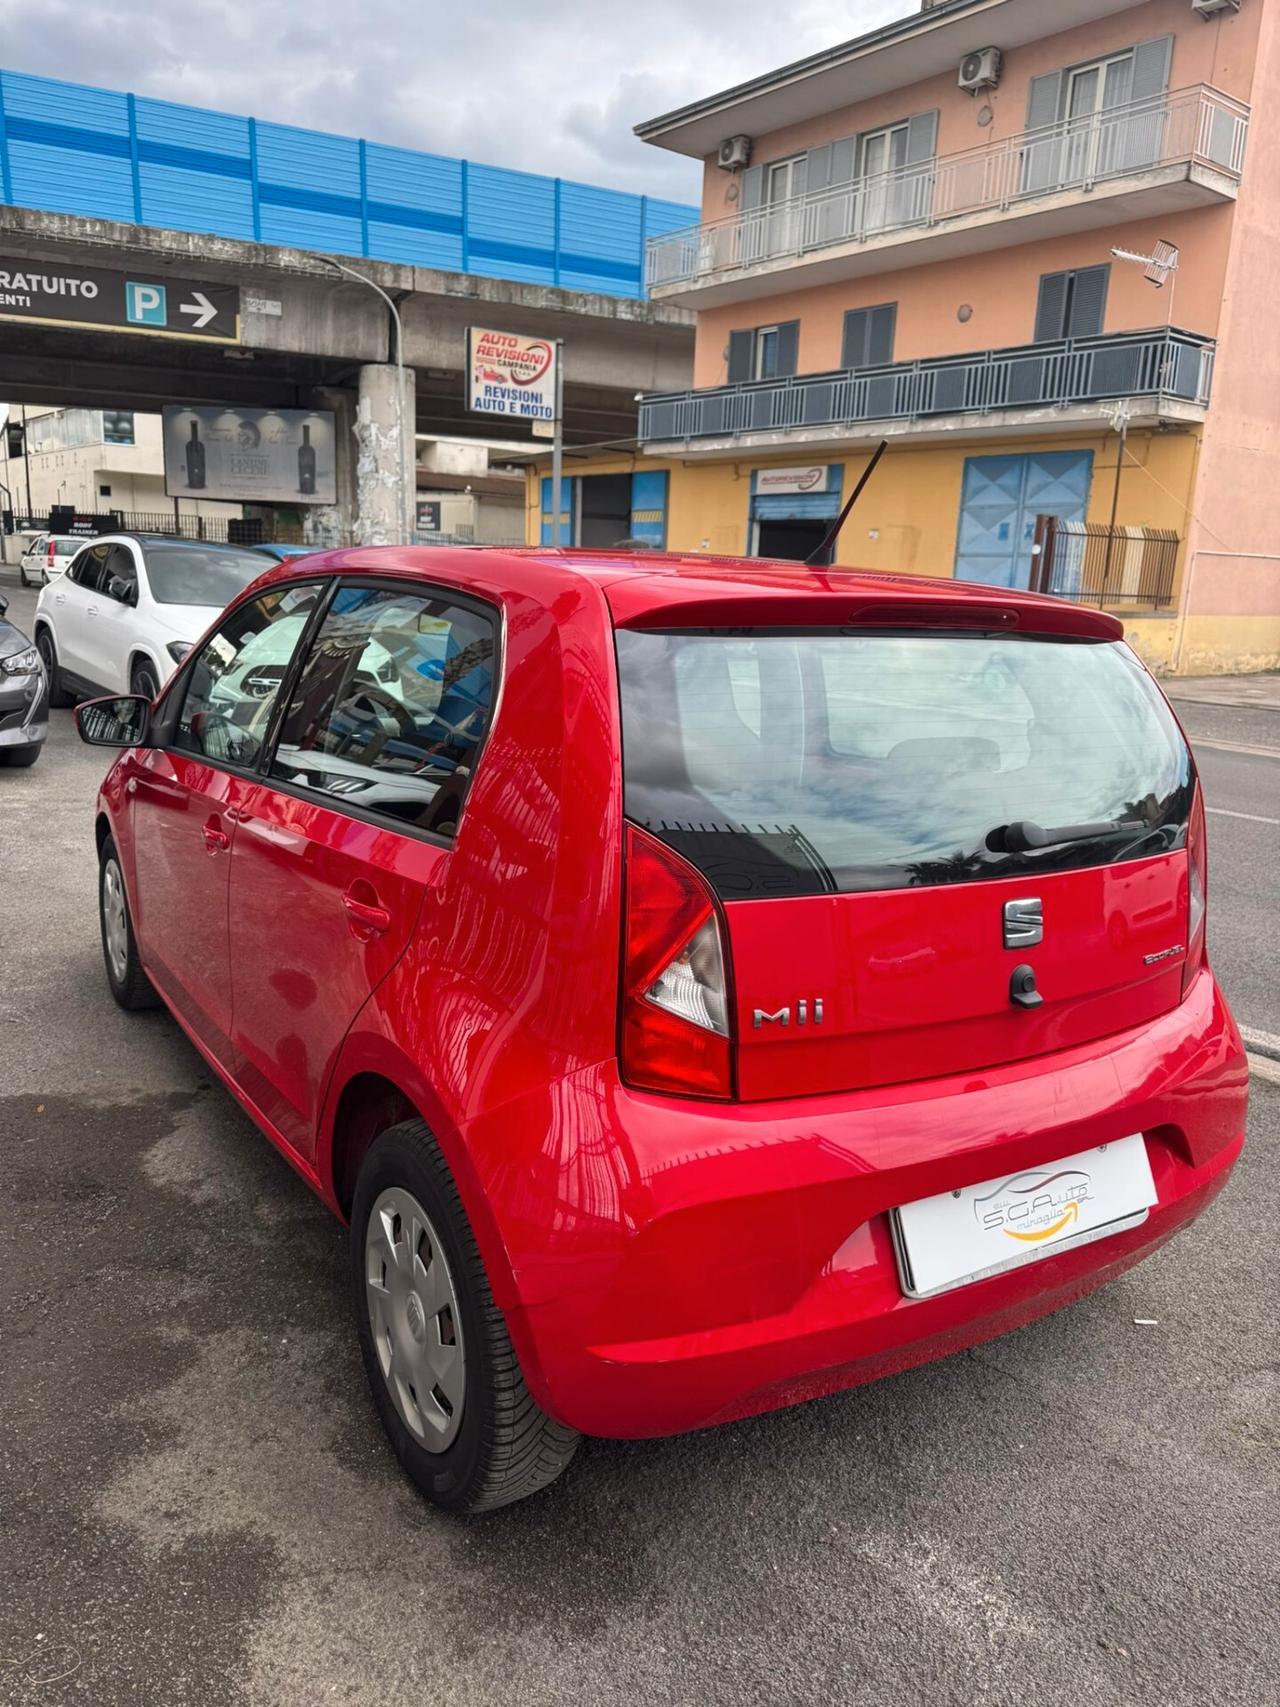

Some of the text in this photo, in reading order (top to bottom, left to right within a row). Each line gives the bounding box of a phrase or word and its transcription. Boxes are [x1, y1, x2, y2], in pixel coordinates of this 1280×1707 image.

[134, 286, 160, 320] P
[480, 333, 518, 348] AUTO
[476, 345, 544, 365] REVISIONI
[497, 359, 537, 372] CAMPANIA
[484, 385, 543, 404] REVISIONI
[474, 397, 552, 418] AUTO E MOTO
[753, 997, 824, 1028] Mii
